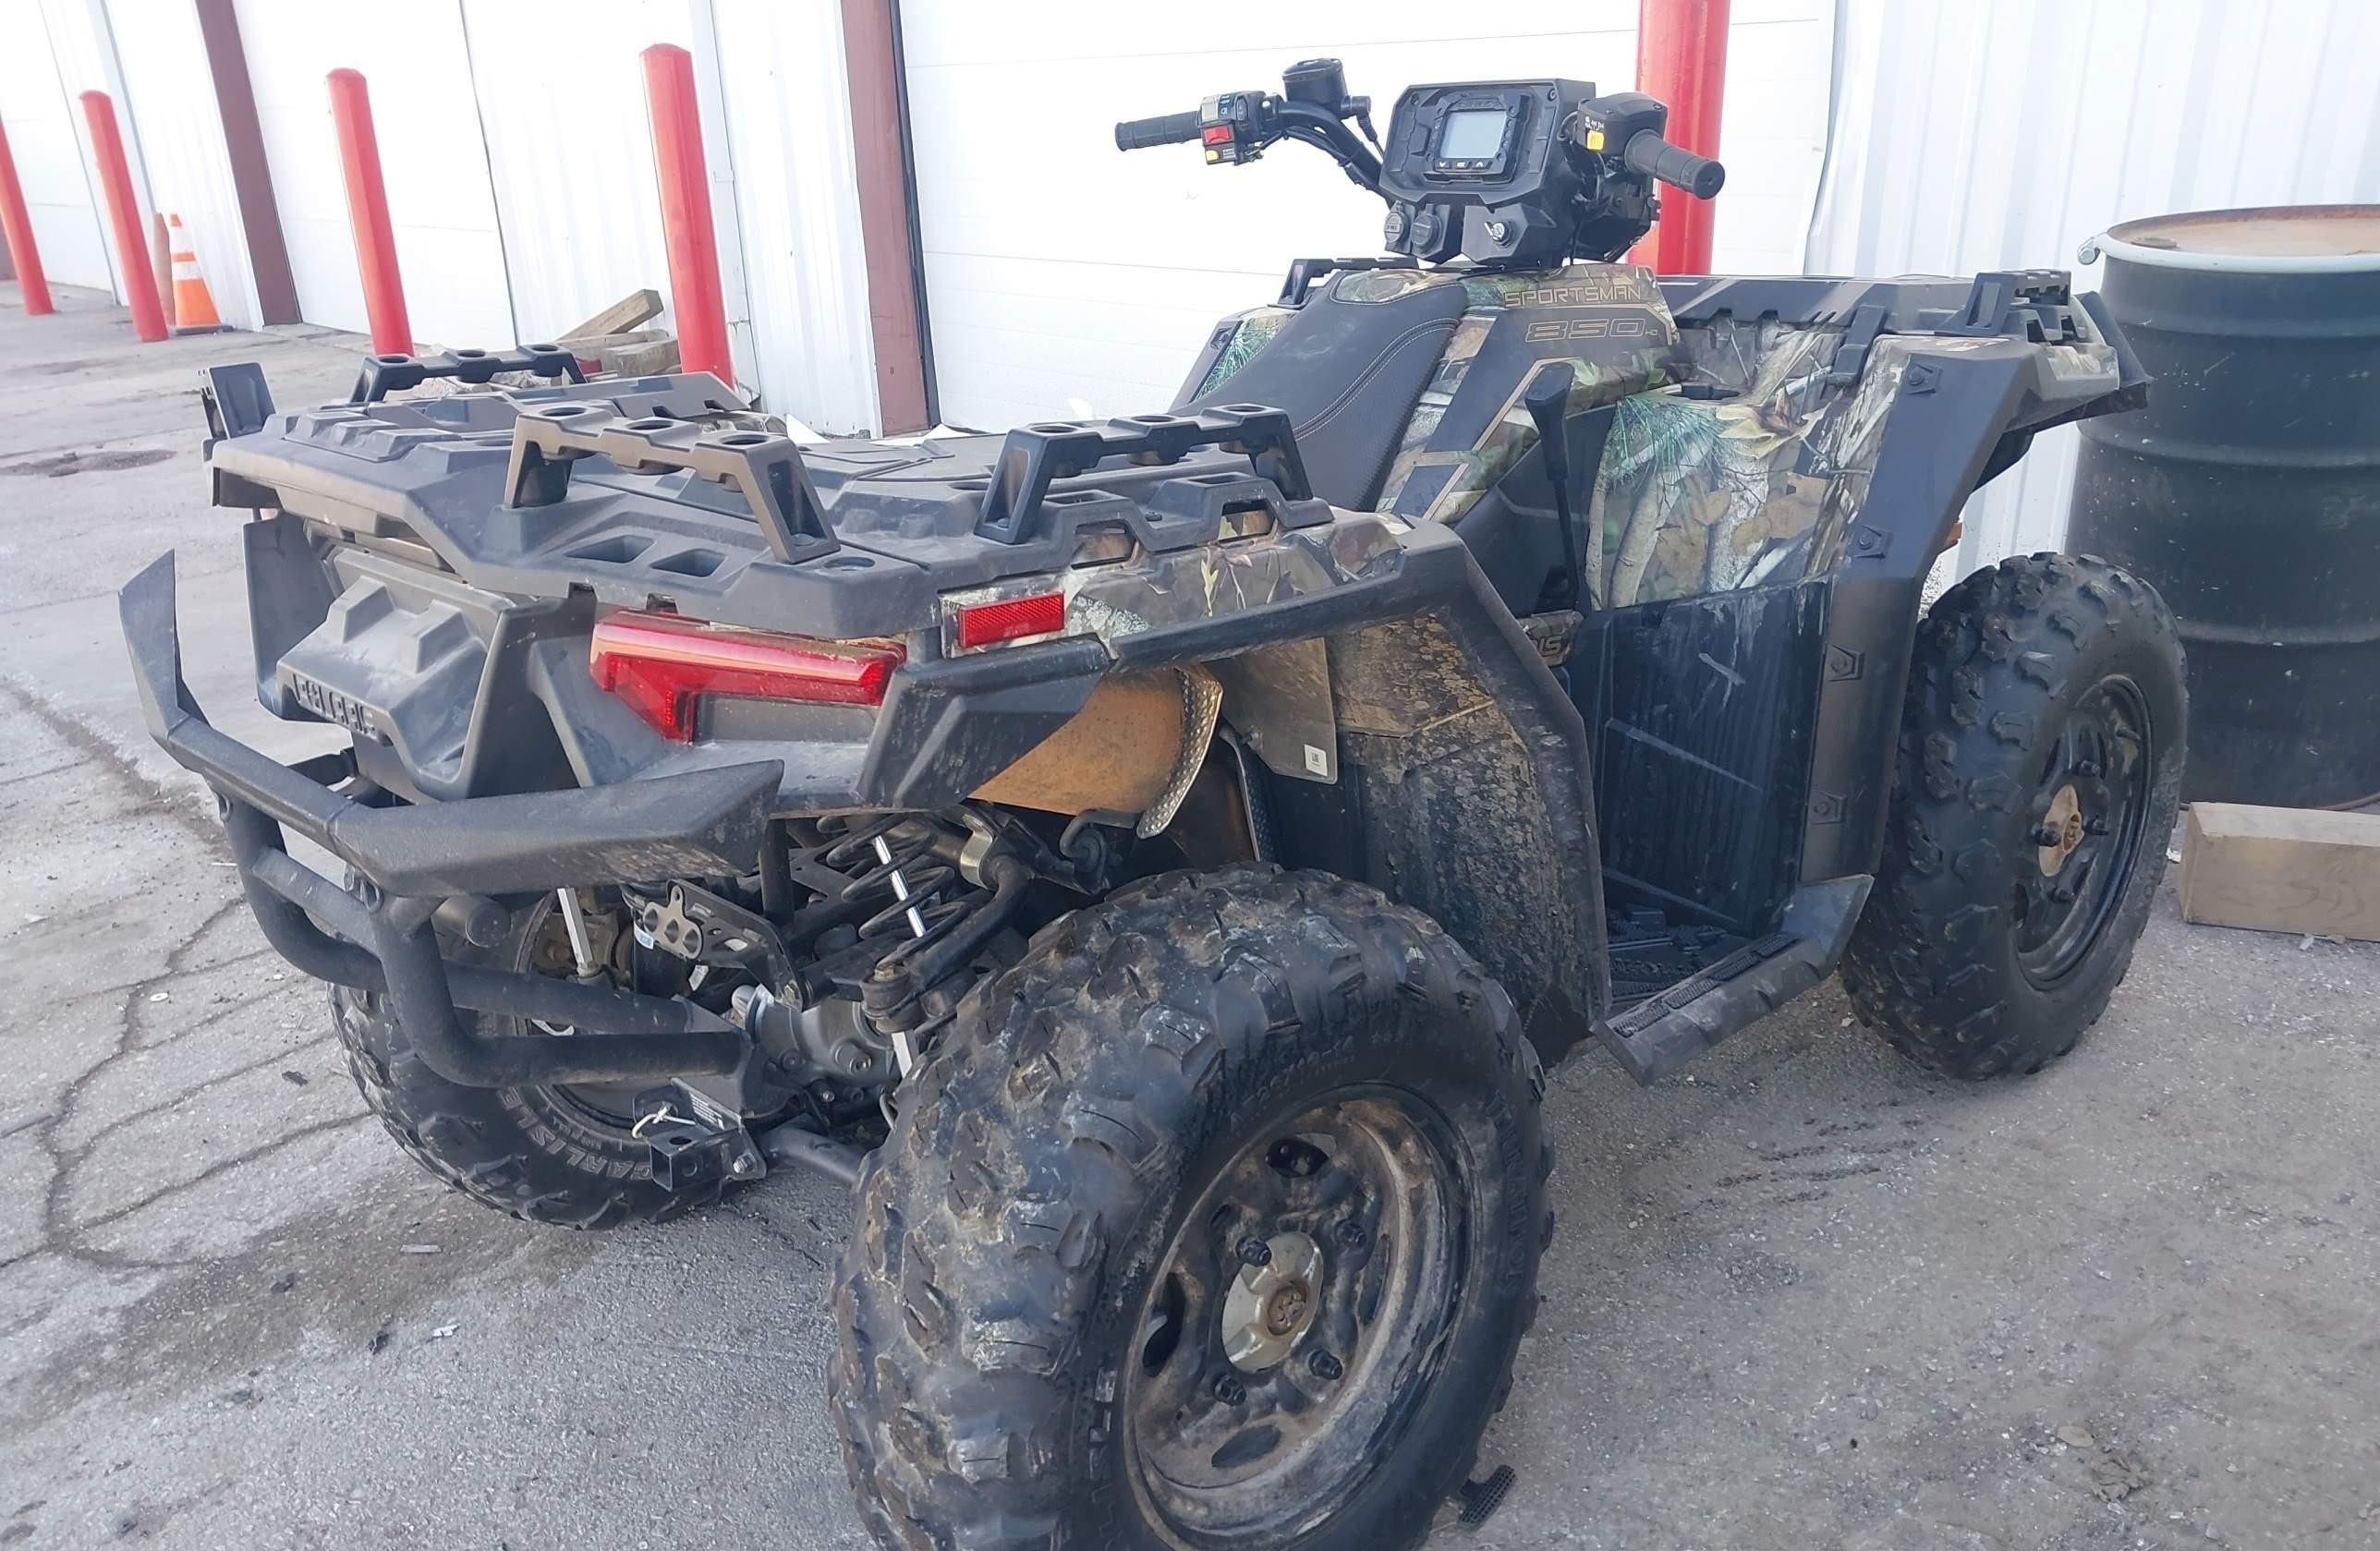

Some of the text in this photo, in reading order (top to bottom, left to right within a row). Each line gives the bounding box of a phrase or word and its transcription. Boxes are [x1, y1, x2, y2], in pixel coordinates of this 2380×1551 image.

[1504, 285, 1641, 307] SPORTSMAN
[1525, 319, 1645, 343] 850
[496, 1086, 652, 1181] CARLISLE
